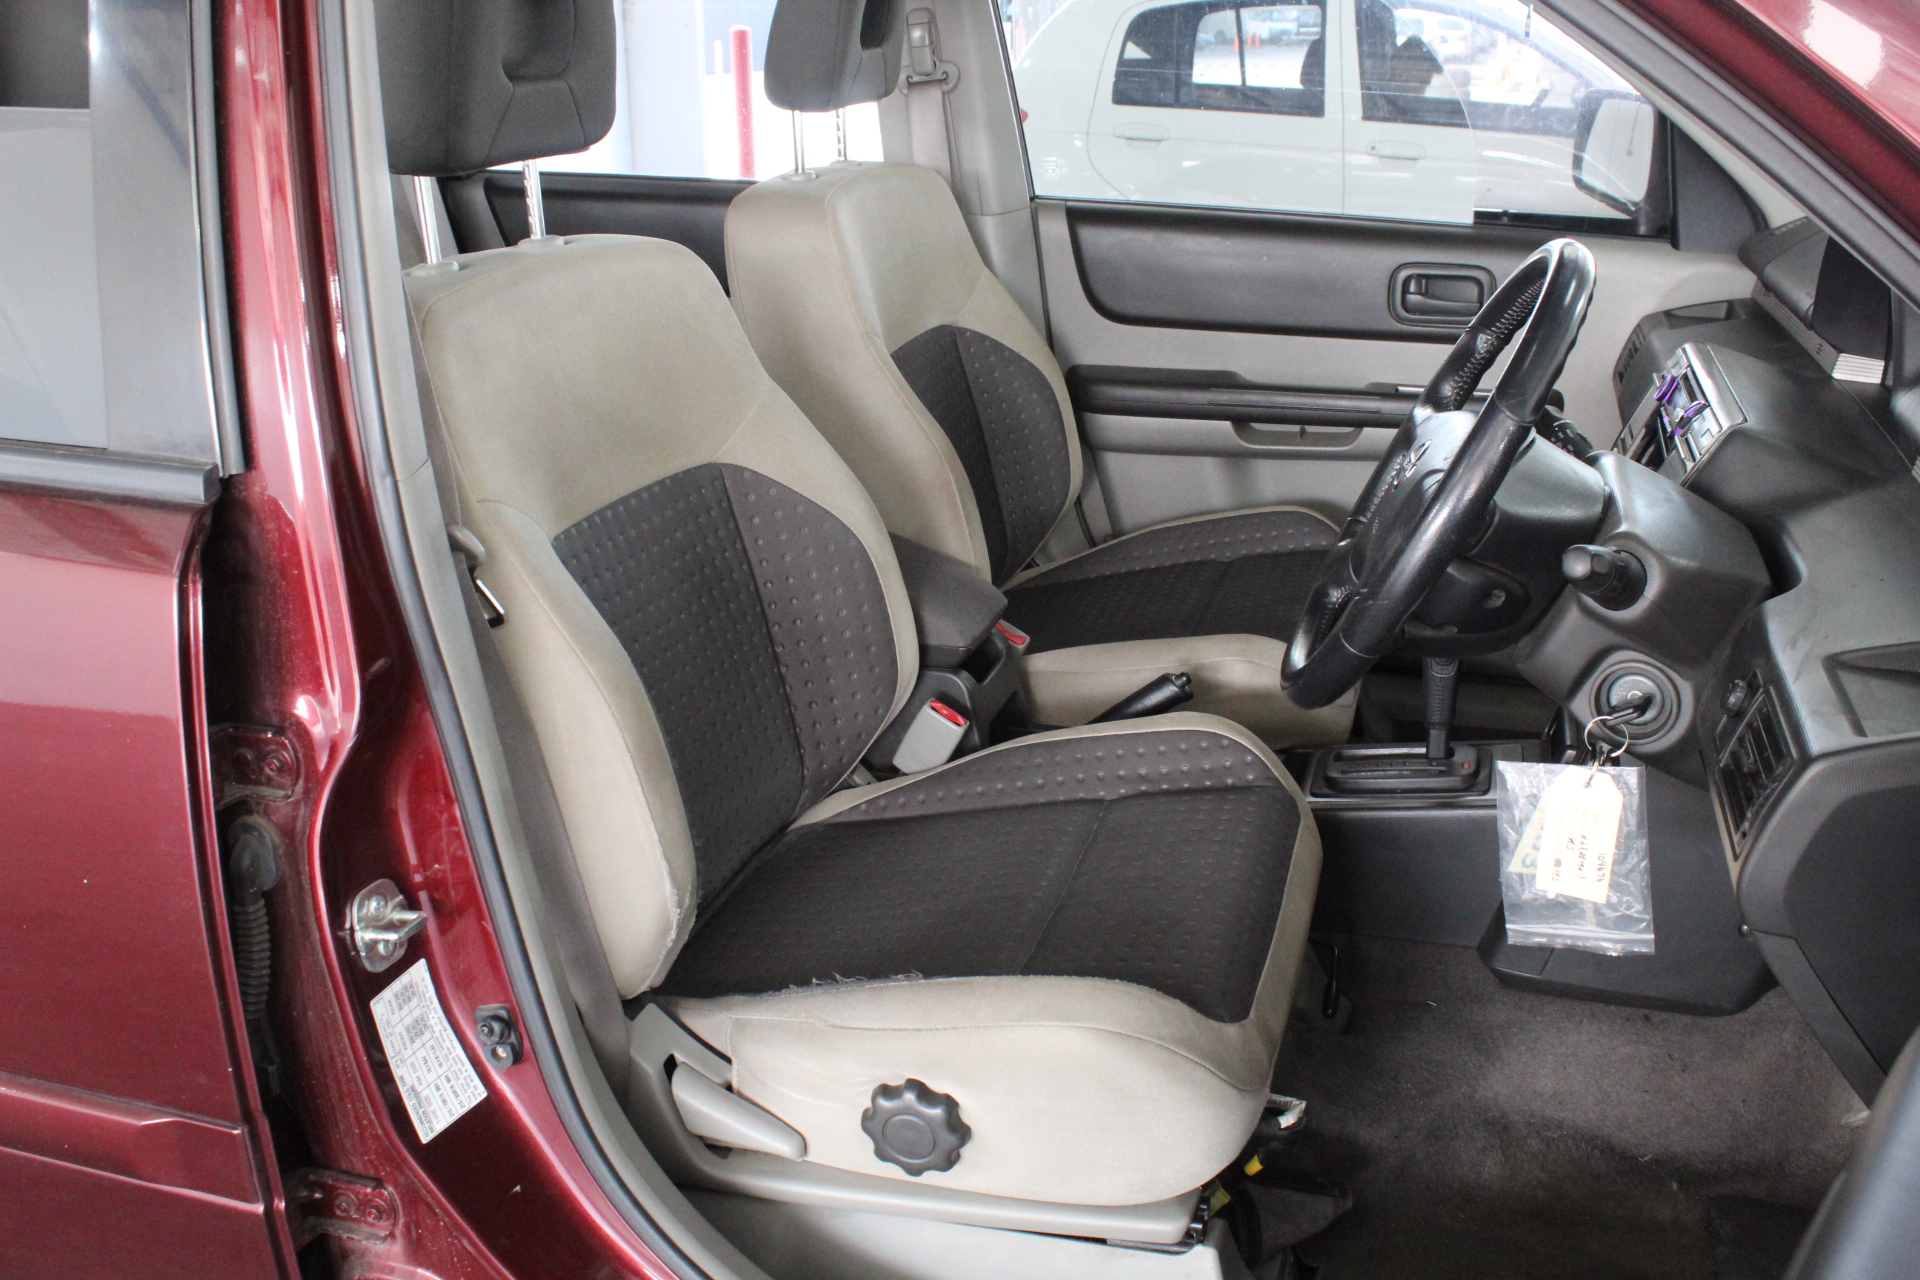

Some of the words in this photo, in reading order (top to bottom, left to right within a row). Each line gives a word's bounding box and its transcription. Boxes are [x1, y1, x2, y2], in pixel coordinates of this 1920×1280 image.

[1552, 869, 1561, 882] YES
[386, 998, 395, 1016] REAR
[388, 1038, 397, 1054] OVER
[397, 1030, 408, 1050] FRONT
[409, 1060, 417, 1074] SIZE
[399, 1074, 407, 1087] TYRE
[405, 1087, 413, 1102] COLD
[409, 1084, 423, 1109] PRESSURE
[423, 1093, 433, 1108] SIZE
[421, 1109, 434, 1134] INFLATION
[431, 1108, 441, 1123] TYRE
